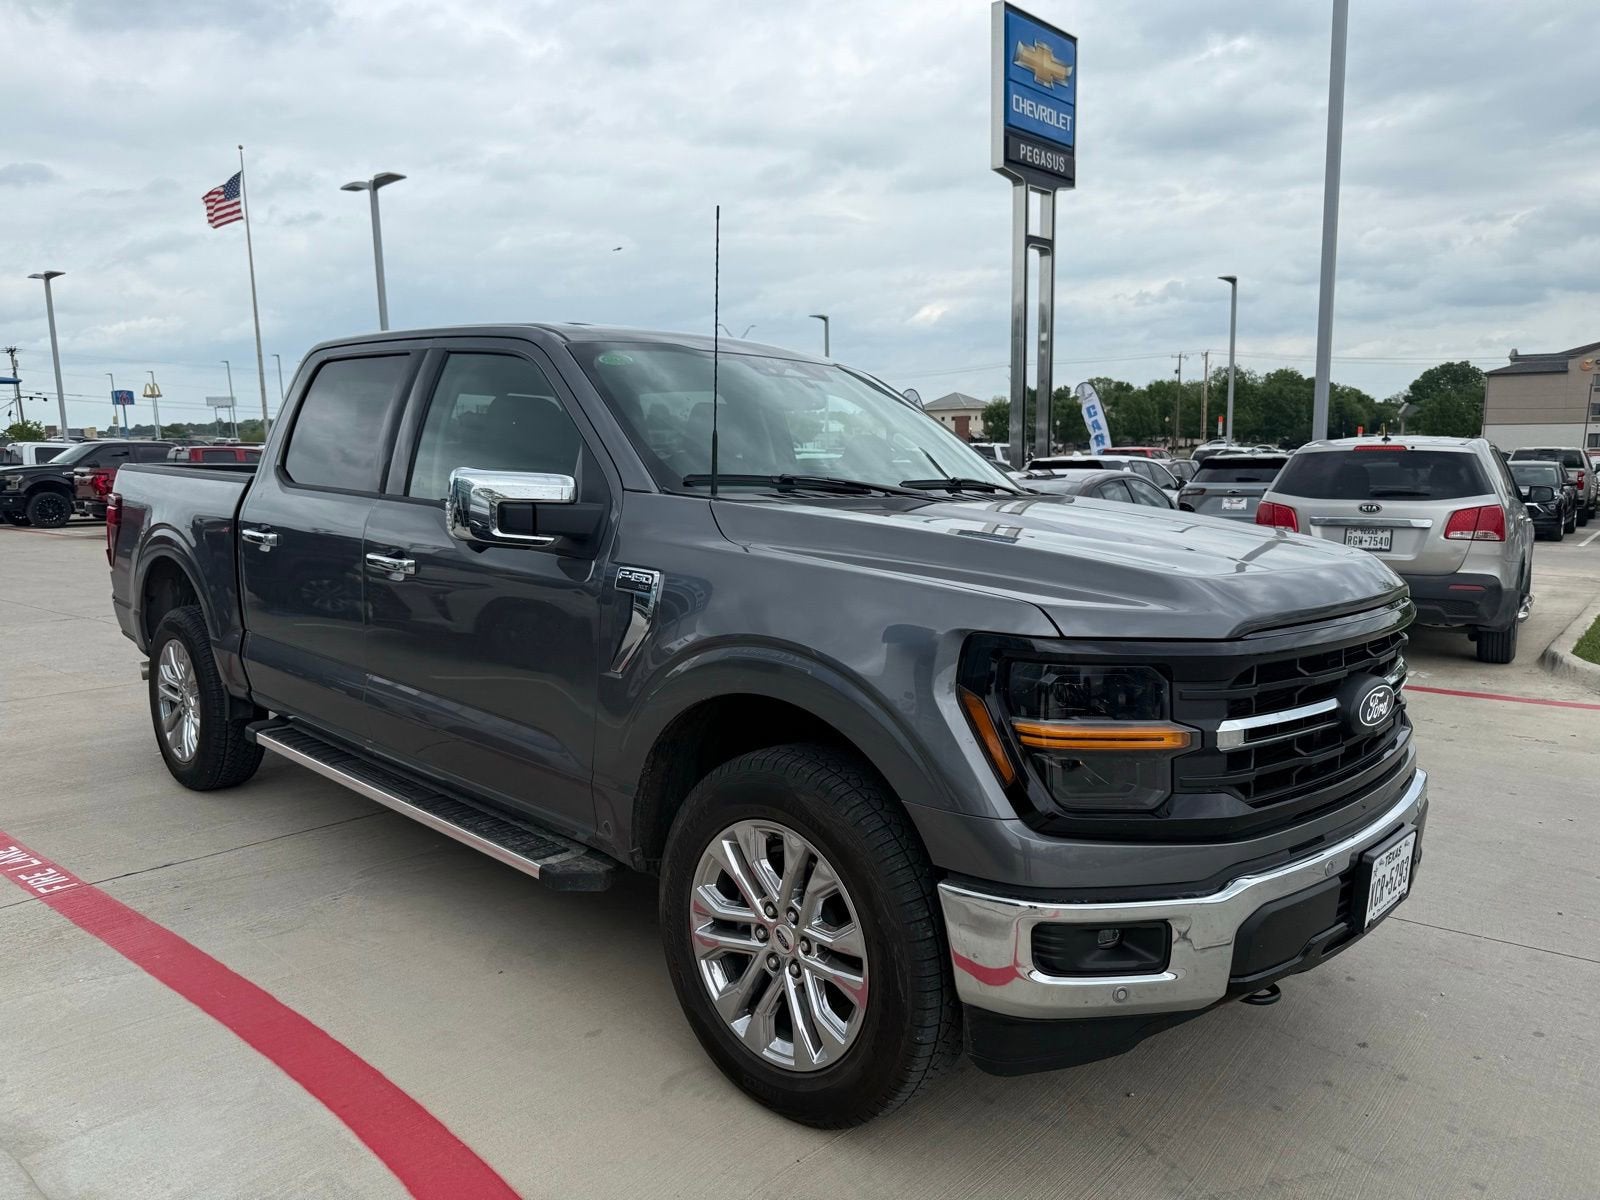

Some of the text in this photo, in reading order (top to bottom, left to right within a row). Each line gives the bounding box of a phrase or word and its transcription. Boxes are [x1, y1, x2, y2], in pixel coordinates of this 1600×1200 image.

[1012, 94, 1072, 131] CHEVROLET
[1020, 143, 1065, 173] PEGASUS
[1366, 691, 1390, 721] Ford
[1384, 846, 1402, 868] TEXAS
[17, 867, 79, 894] FIRE
